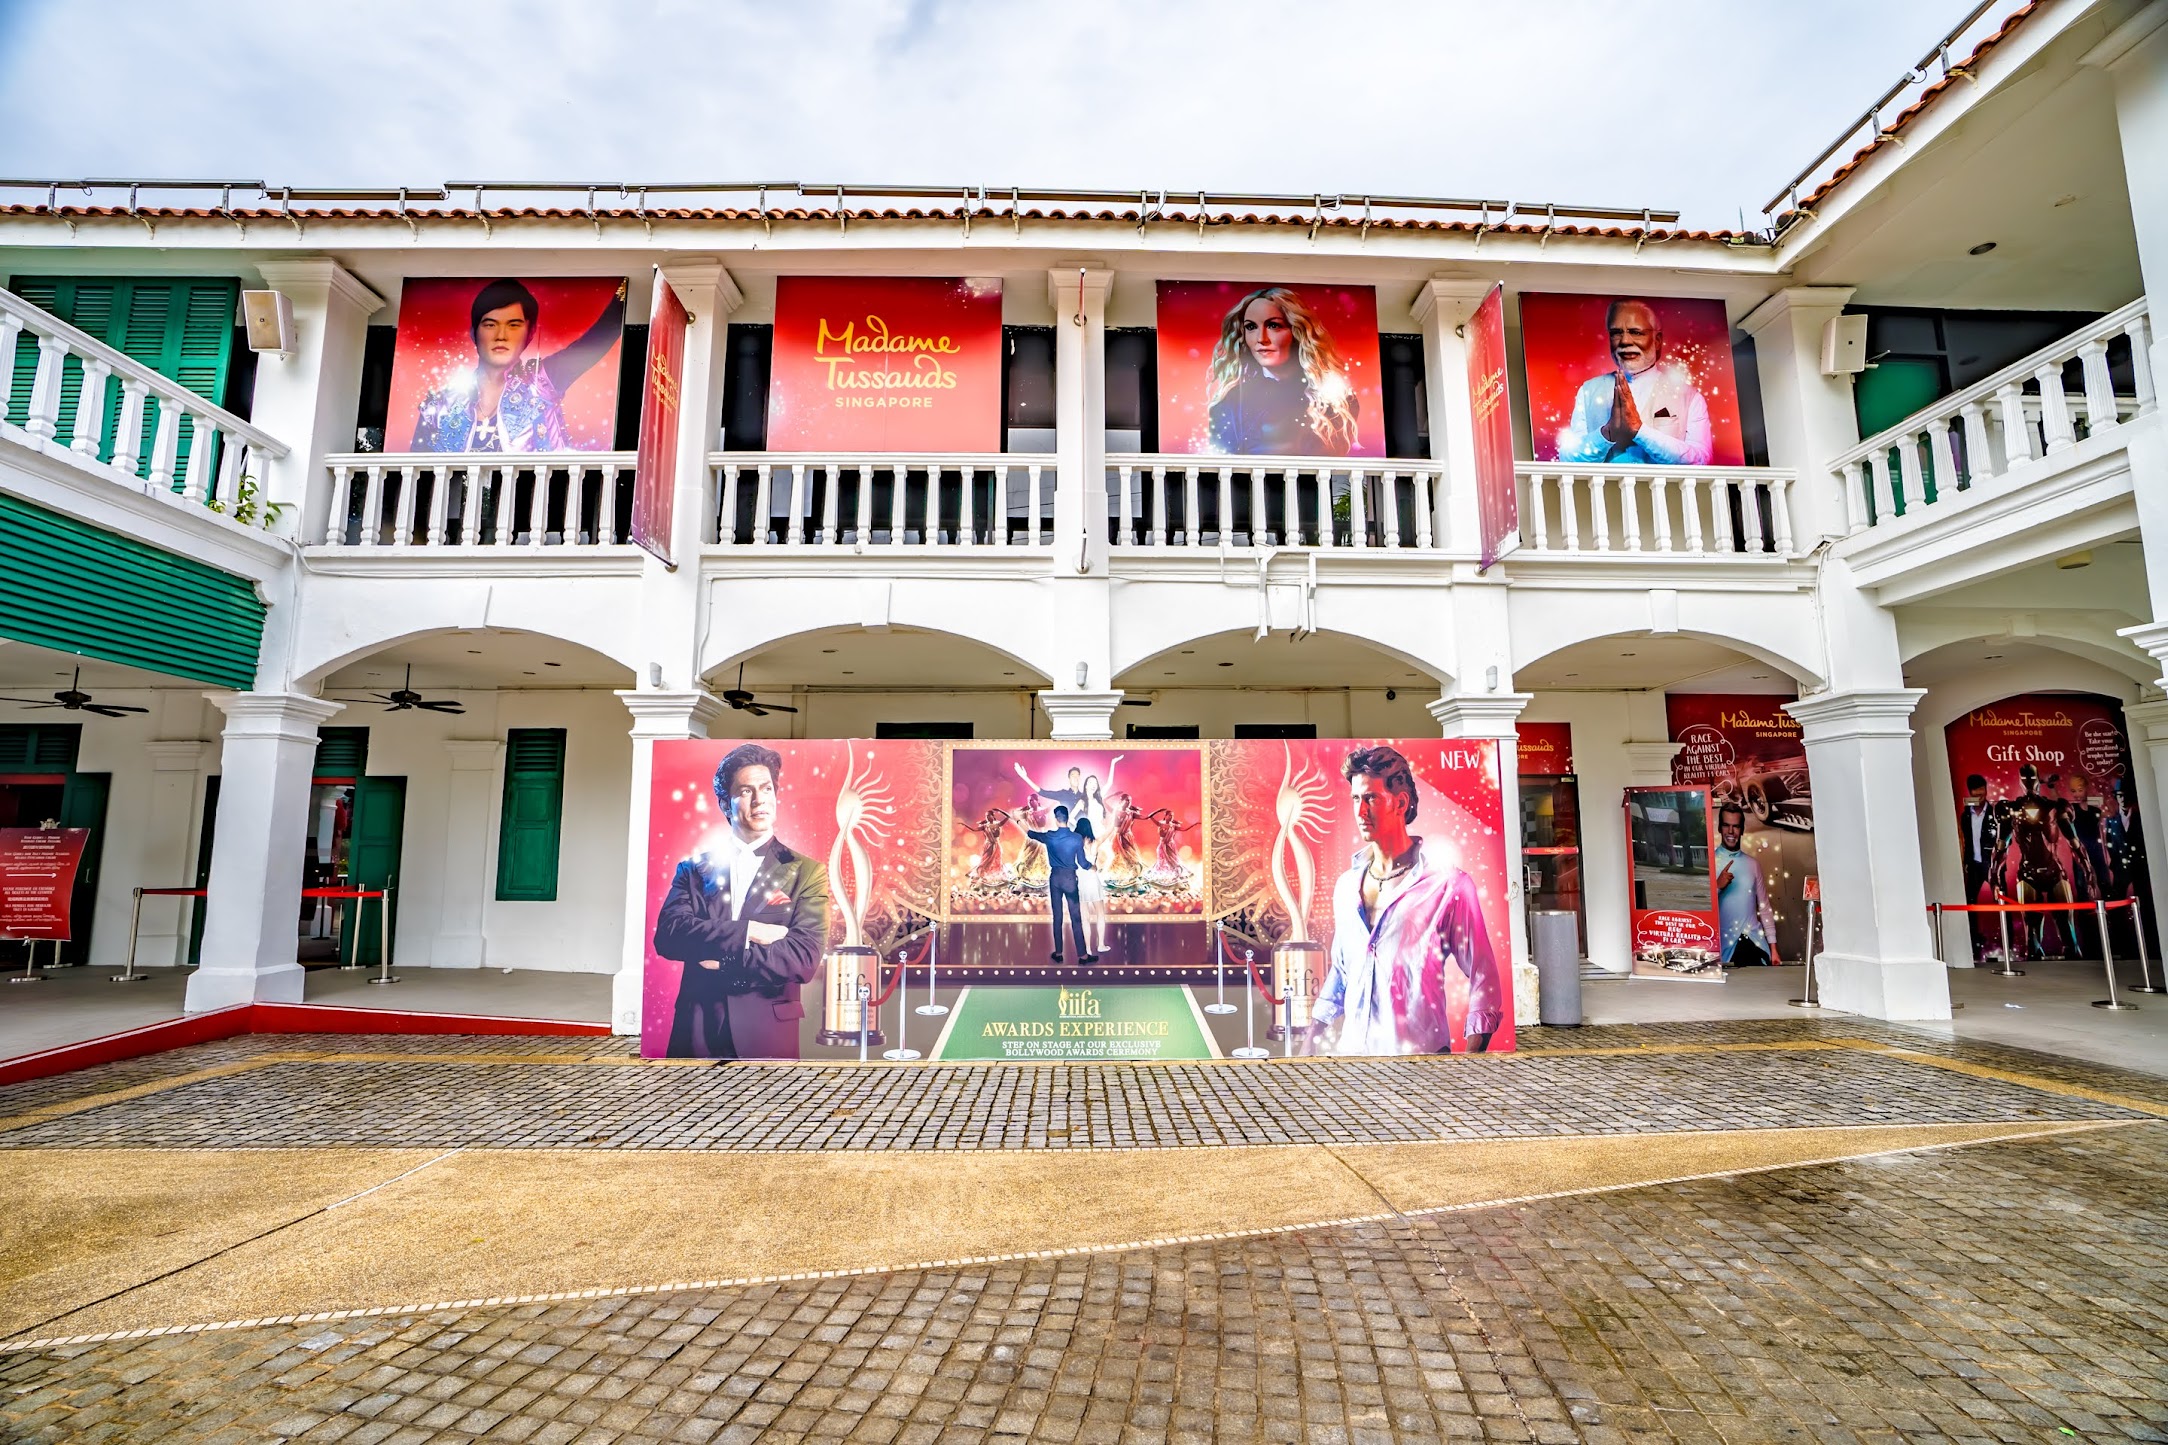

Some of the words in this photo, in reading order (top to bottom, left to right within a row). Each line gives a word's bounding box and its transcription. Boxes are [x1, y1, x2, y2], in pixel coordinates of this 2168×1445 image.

[817, 314, 961, 354] Madame
[813, 354, 957, 391] Tussauds
[835, 397, 933, 408] SINGAPORE
[1721, 710, 1777, 729] Madame
[1772, 713, 1802, 729] Tuss
[1969, 710, 2024, 727] Madame
[2019, 711, 2073, 728] Tussauds
[1517, 738, 1555, 752] ussauds
[1690, 733, 1713, 744] RACE
[1686, 743, 1720, 755] AGAINST
[1987, 745, 2021, 762] Gift
[2025, 744, 2065, 766] Shop
[1440, 750, 1480, 769] NEW
[1685, 755, 1701, 765] THE
[1702, 754, 1723, 764] BEST
[1715, 769, 1731, 777] CARS
[1649, 930, 1674, 938] VIRTUAL
[1675, 933, 1701, 941] REALITY
[1068, 989, 1101, 1016] iifa
[981, 1022, 1054, 1037] AWARDS
[1059, 1021, 1169, 1037] EXPERIENCE
[1002, 1041, 1025, 1049] STEP
[1026, 1041, 1039, 1049] ON
[1042, 1041, 1072, 1049] STAGE
[1074, 1041, 1085, 1049] AT
[1087, 1041, 1107, 1049] OUR
[1109, 1040, 1161, 1048] EXCLUSIVE
[1005, 1049, 1064, 1057] BOLLYWOOD
[1106, 1048, 1158, 1056] CEREMONY
